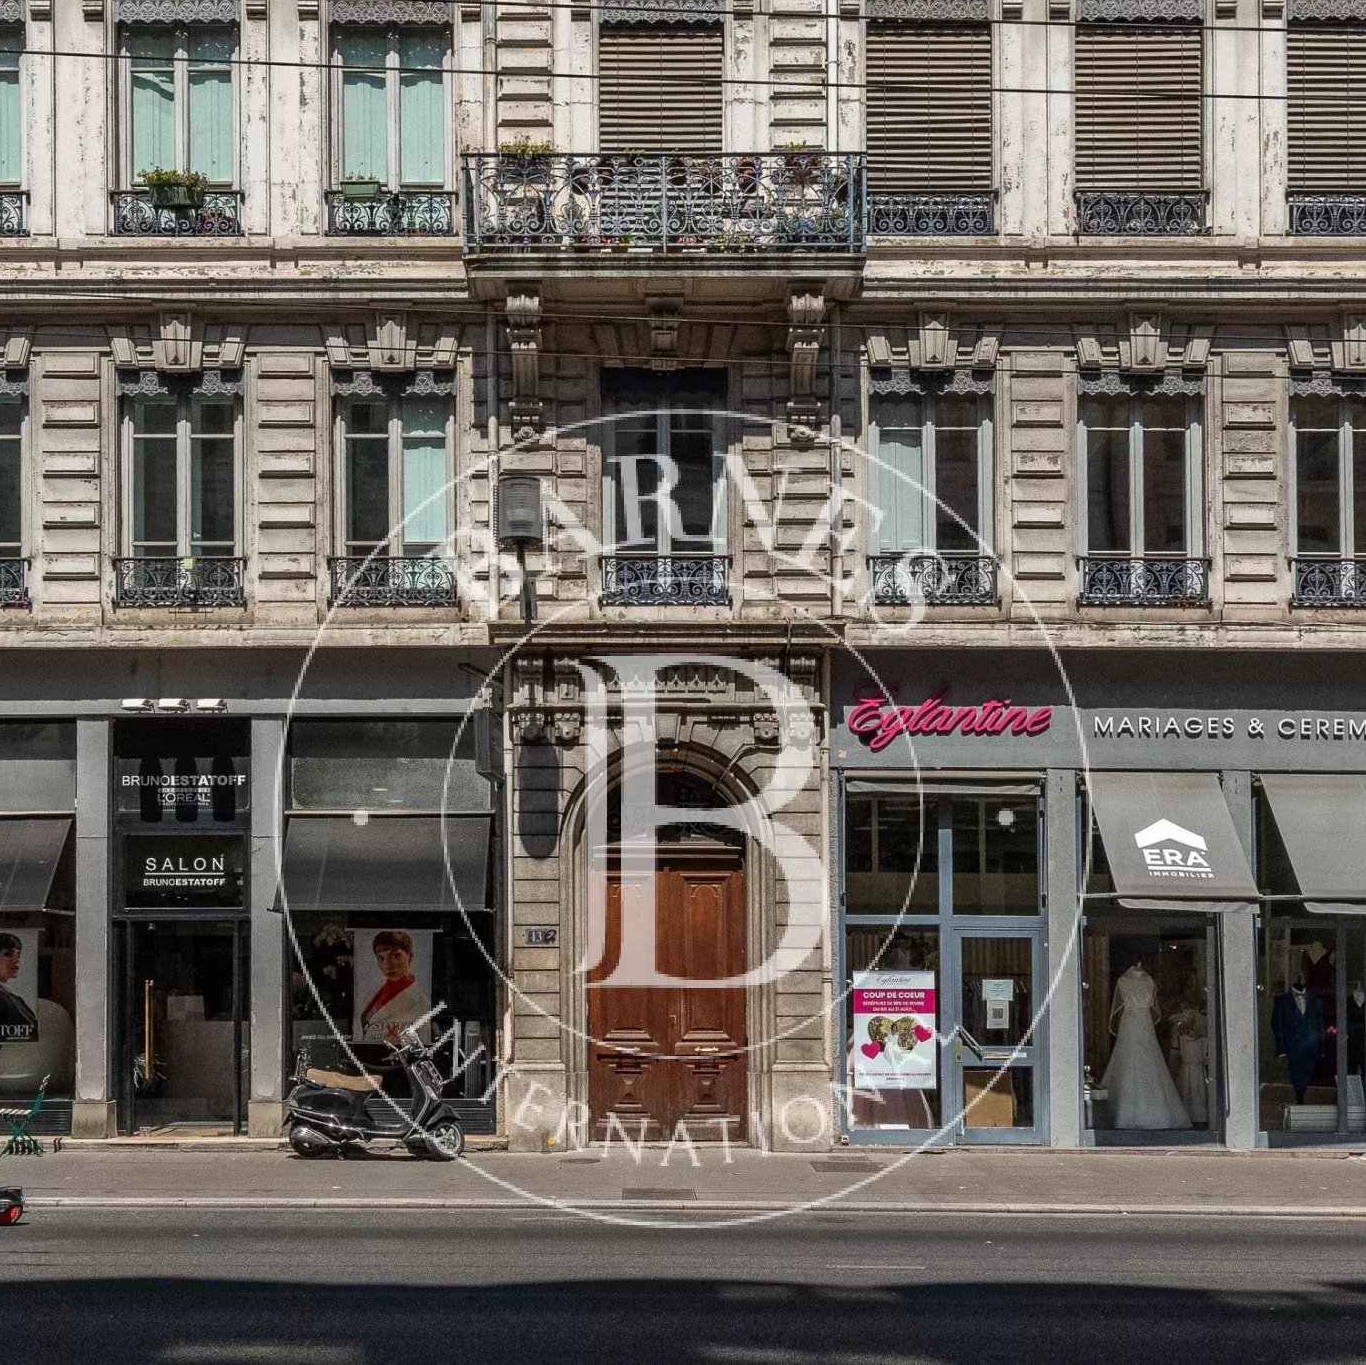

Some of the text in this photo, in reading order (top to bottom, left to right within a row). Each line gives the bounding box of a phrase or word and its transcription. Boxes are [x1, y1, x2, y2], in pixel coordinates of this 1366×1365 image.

[848, 689, 1053, 749] Eglantine
[1094, 716, 1235, 734] MARIAGES
[1248, 717, 1265, 734] &
[122, 775, 246, 786] BRUNOESTATOFF
[145, 857, 225, 871] SALON
[1142, 849, 1210, 867] ERA
[1149, 871, 1215, 879] IMMOBILIER
[143, 878, 226, 887] BRUNOESTATOFF
